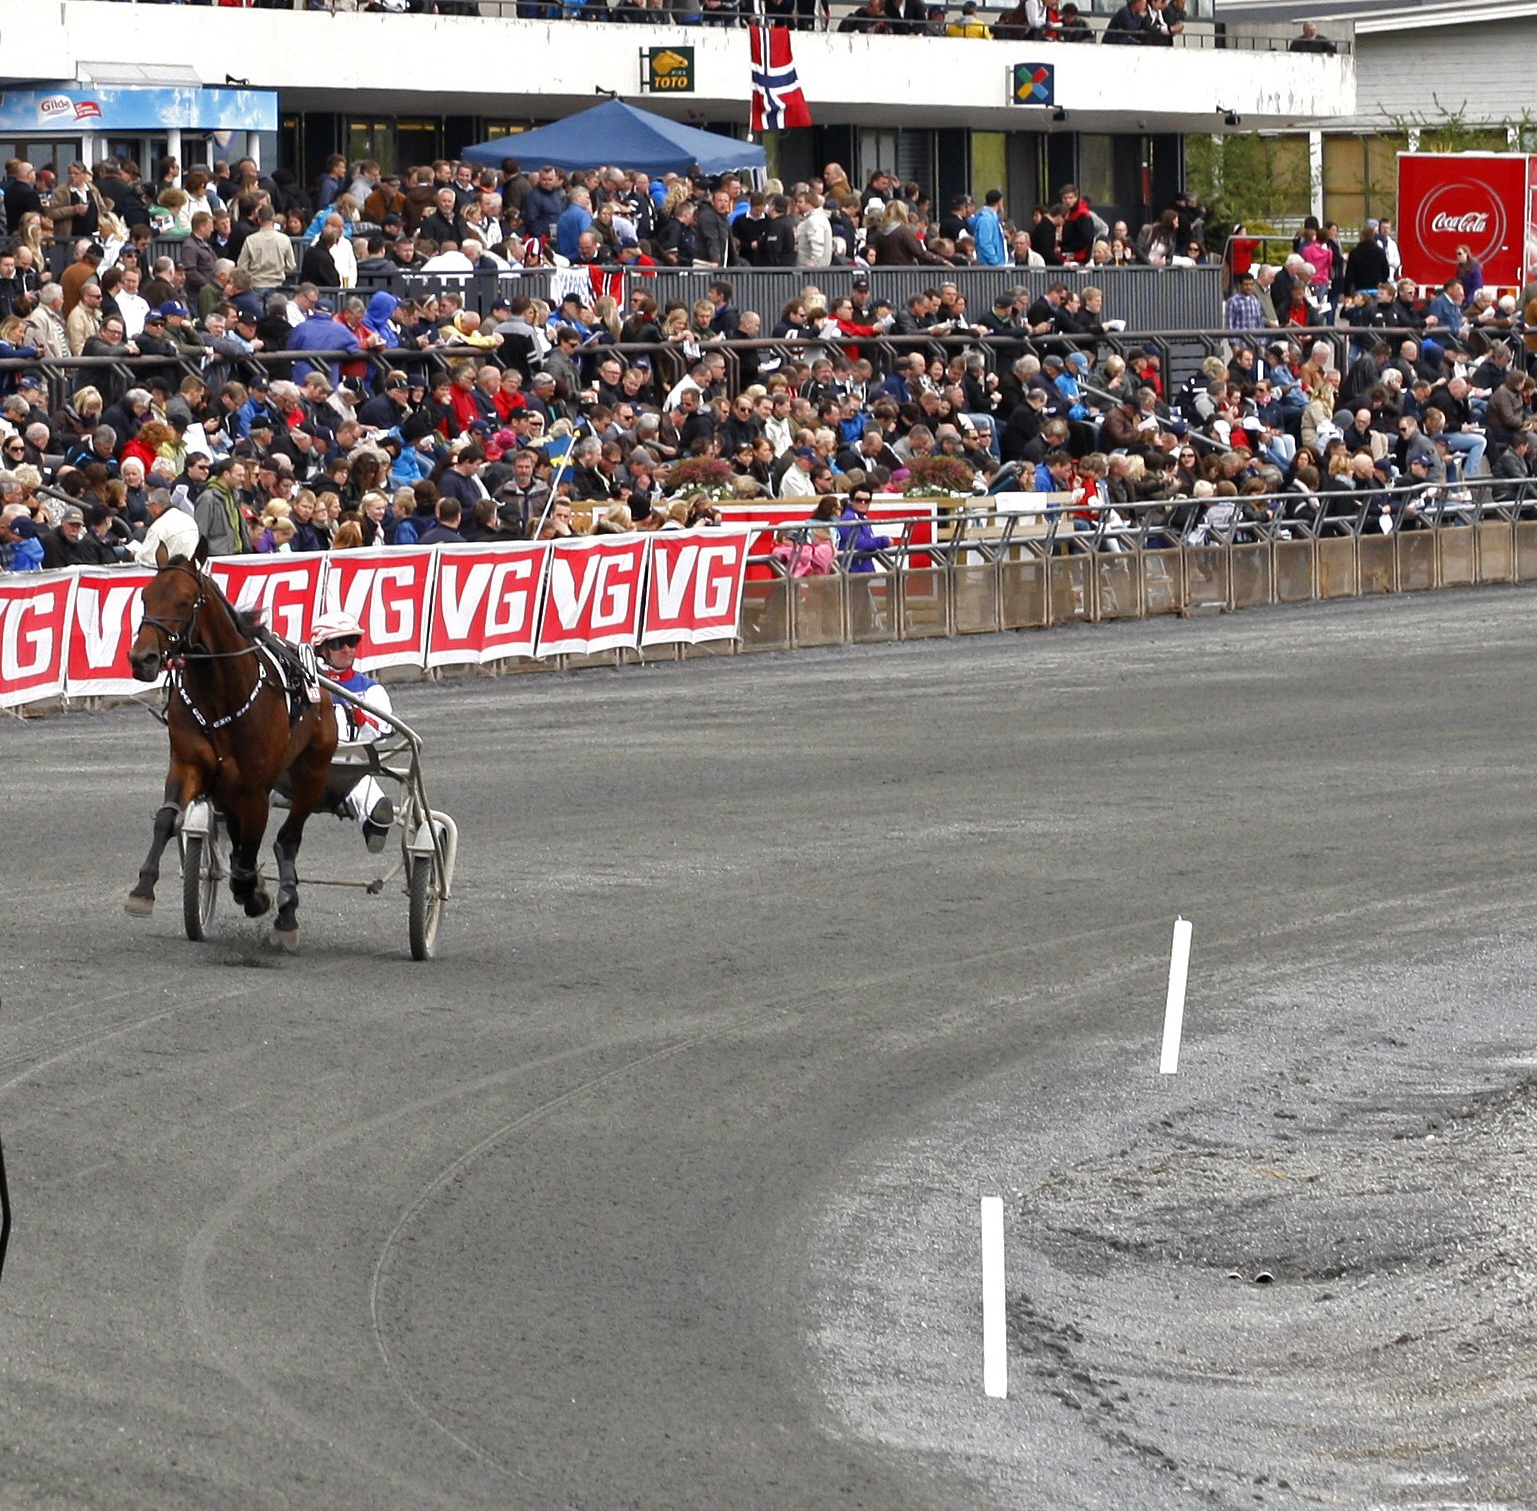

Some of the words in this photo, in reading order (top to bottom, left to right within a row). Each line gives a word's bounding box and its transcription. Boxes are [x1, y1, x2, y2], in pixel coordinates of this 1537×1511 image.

[41, 100, 70, 112] Gilde
[654, 76, 688, 88] TOTO
[326, 565, 416, 645] VG
[441, 559, 533, 640] VG
[551, 552, 634, 630] VG
[654, 545, 737, 620] VG
[76, 586, 144, 670] V
